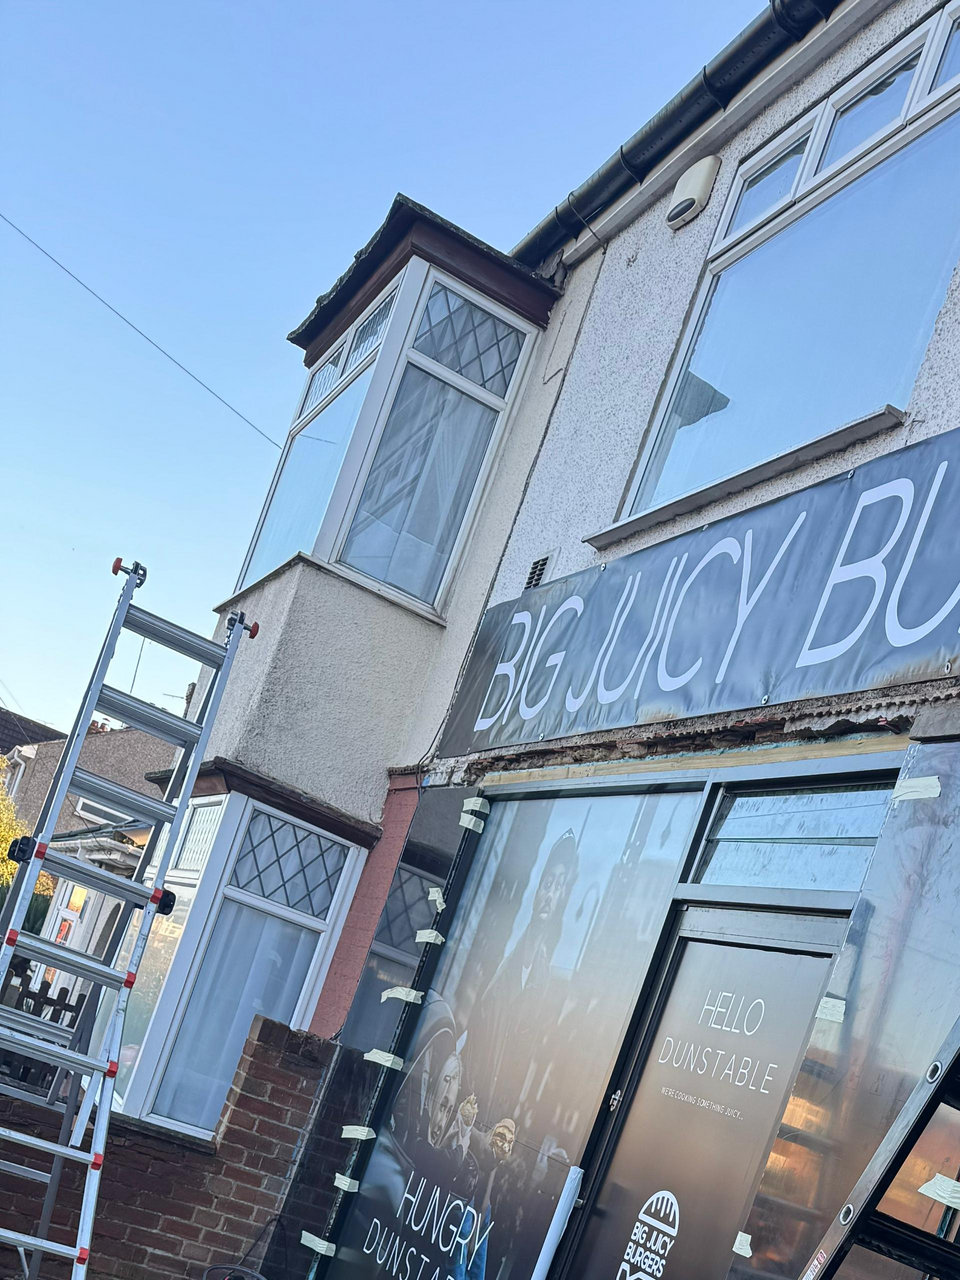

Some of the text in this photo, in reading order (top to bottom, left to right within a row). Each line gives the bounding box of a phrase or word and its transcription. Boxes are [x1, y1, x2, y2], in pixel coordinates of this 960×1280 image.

[475, 595, 584, 731] BIG
[564, 511, 806, 713] JUICY
[698, 989, 765, 1036] HELLO
[658, 1037, 778, 1094] DUNSTABLE
[697, 1097, 725, 1114] SOMETHING
[397, 1170, 495, 1271] HUNGRY
[630, 1221, 675, 1257] BIG JUICY
[623, 1241, 667, 1278] BURGERS
